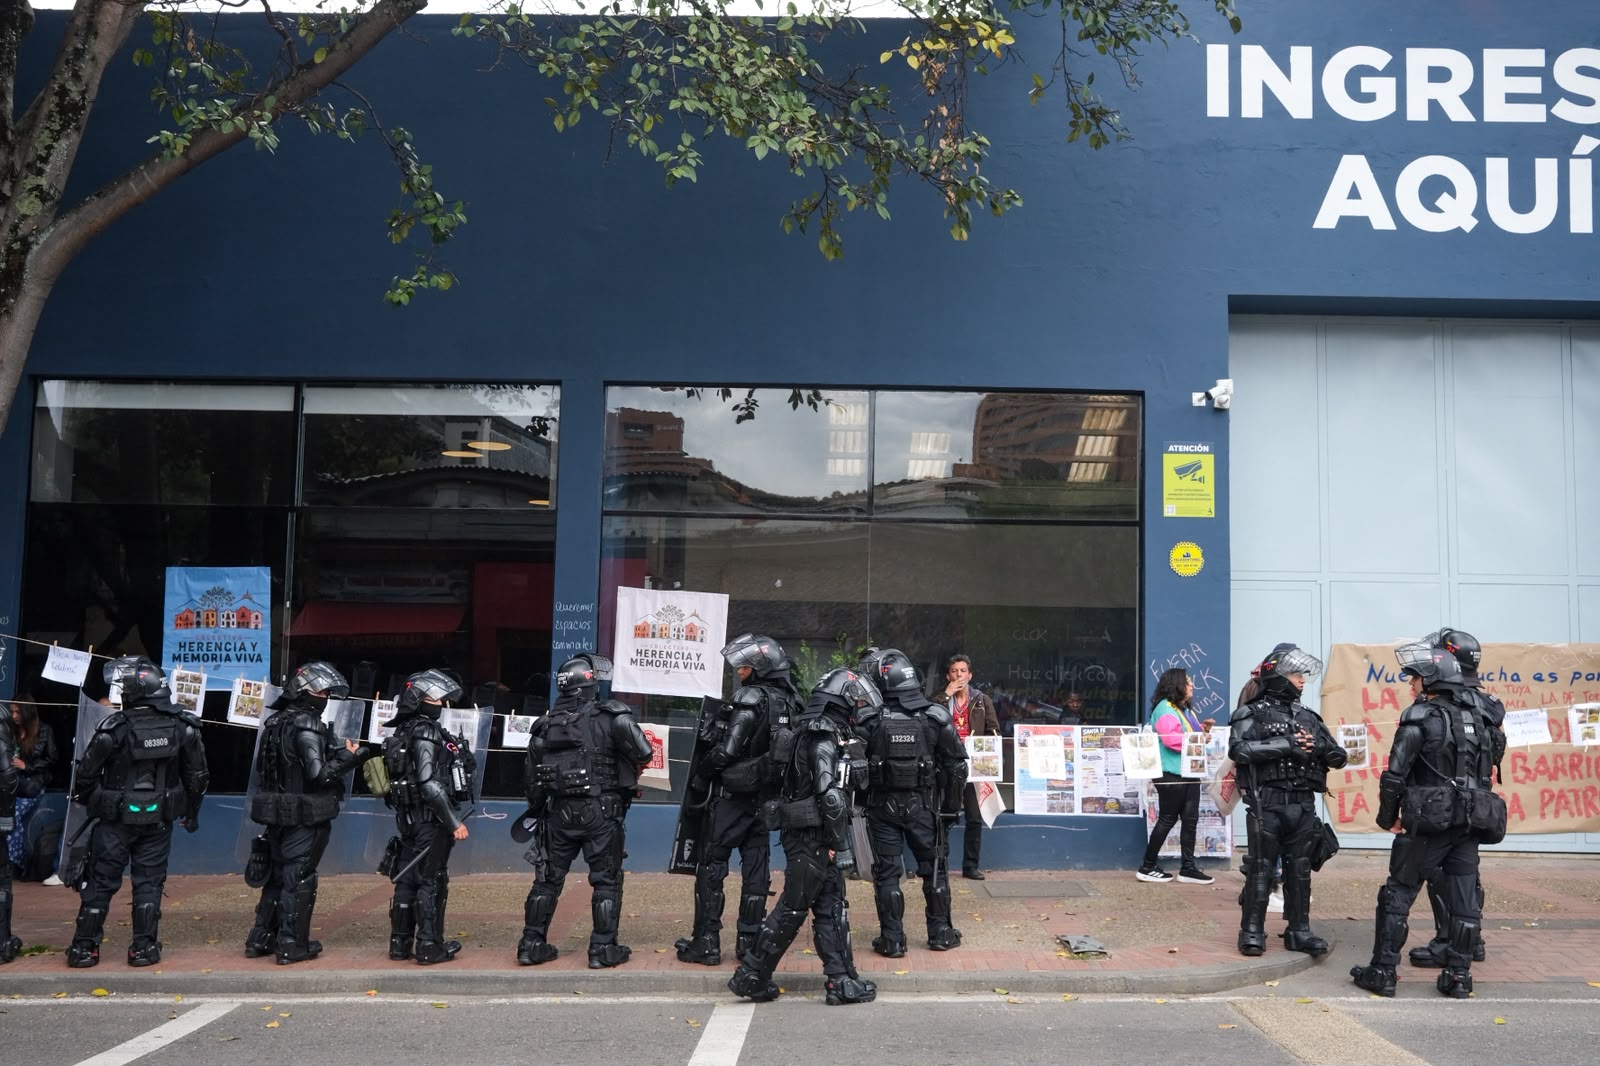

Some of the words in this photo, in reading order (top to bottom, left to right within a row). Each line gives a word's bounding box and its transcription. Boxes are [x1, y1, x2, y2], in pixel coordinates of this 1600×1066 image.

[1207, 44, 1600, 124] INGRES
[1312, 134, 1600, 233] AQUÍ
[1168, 443, 1210, 452] ATENCIÓN
[555, 601, 595, 613] Queremos
[554, 619, 593, 637] espacios
[178, 641, 247, 653] HERENCIA
[250, 641, 258, 652] Y
[171, 652, 234, 664] MEMORIA
[235, 652, 263, 663] VIVA
[635, 648, 693, 661] HERENCIA
[695, 652, 702, 662] Y
[629, 657, 680, 670] MEMORIA
[682, 661, 706, 671] VIVA
[1008, 664, 1041, 680] Haz
[1044, 664, 1082, 681] click
[1477, 665, 1521, 682] ucha
[1504, 684, 1531, 696] TUYA
[1361, 687, 1400, 713] LA
[1541, 692, 1558, 705] LA
[891, 735, 915, 743] 132324
[1338, 790, 1370, 823] LA
[1539, 785, 1600, 820] PATR
